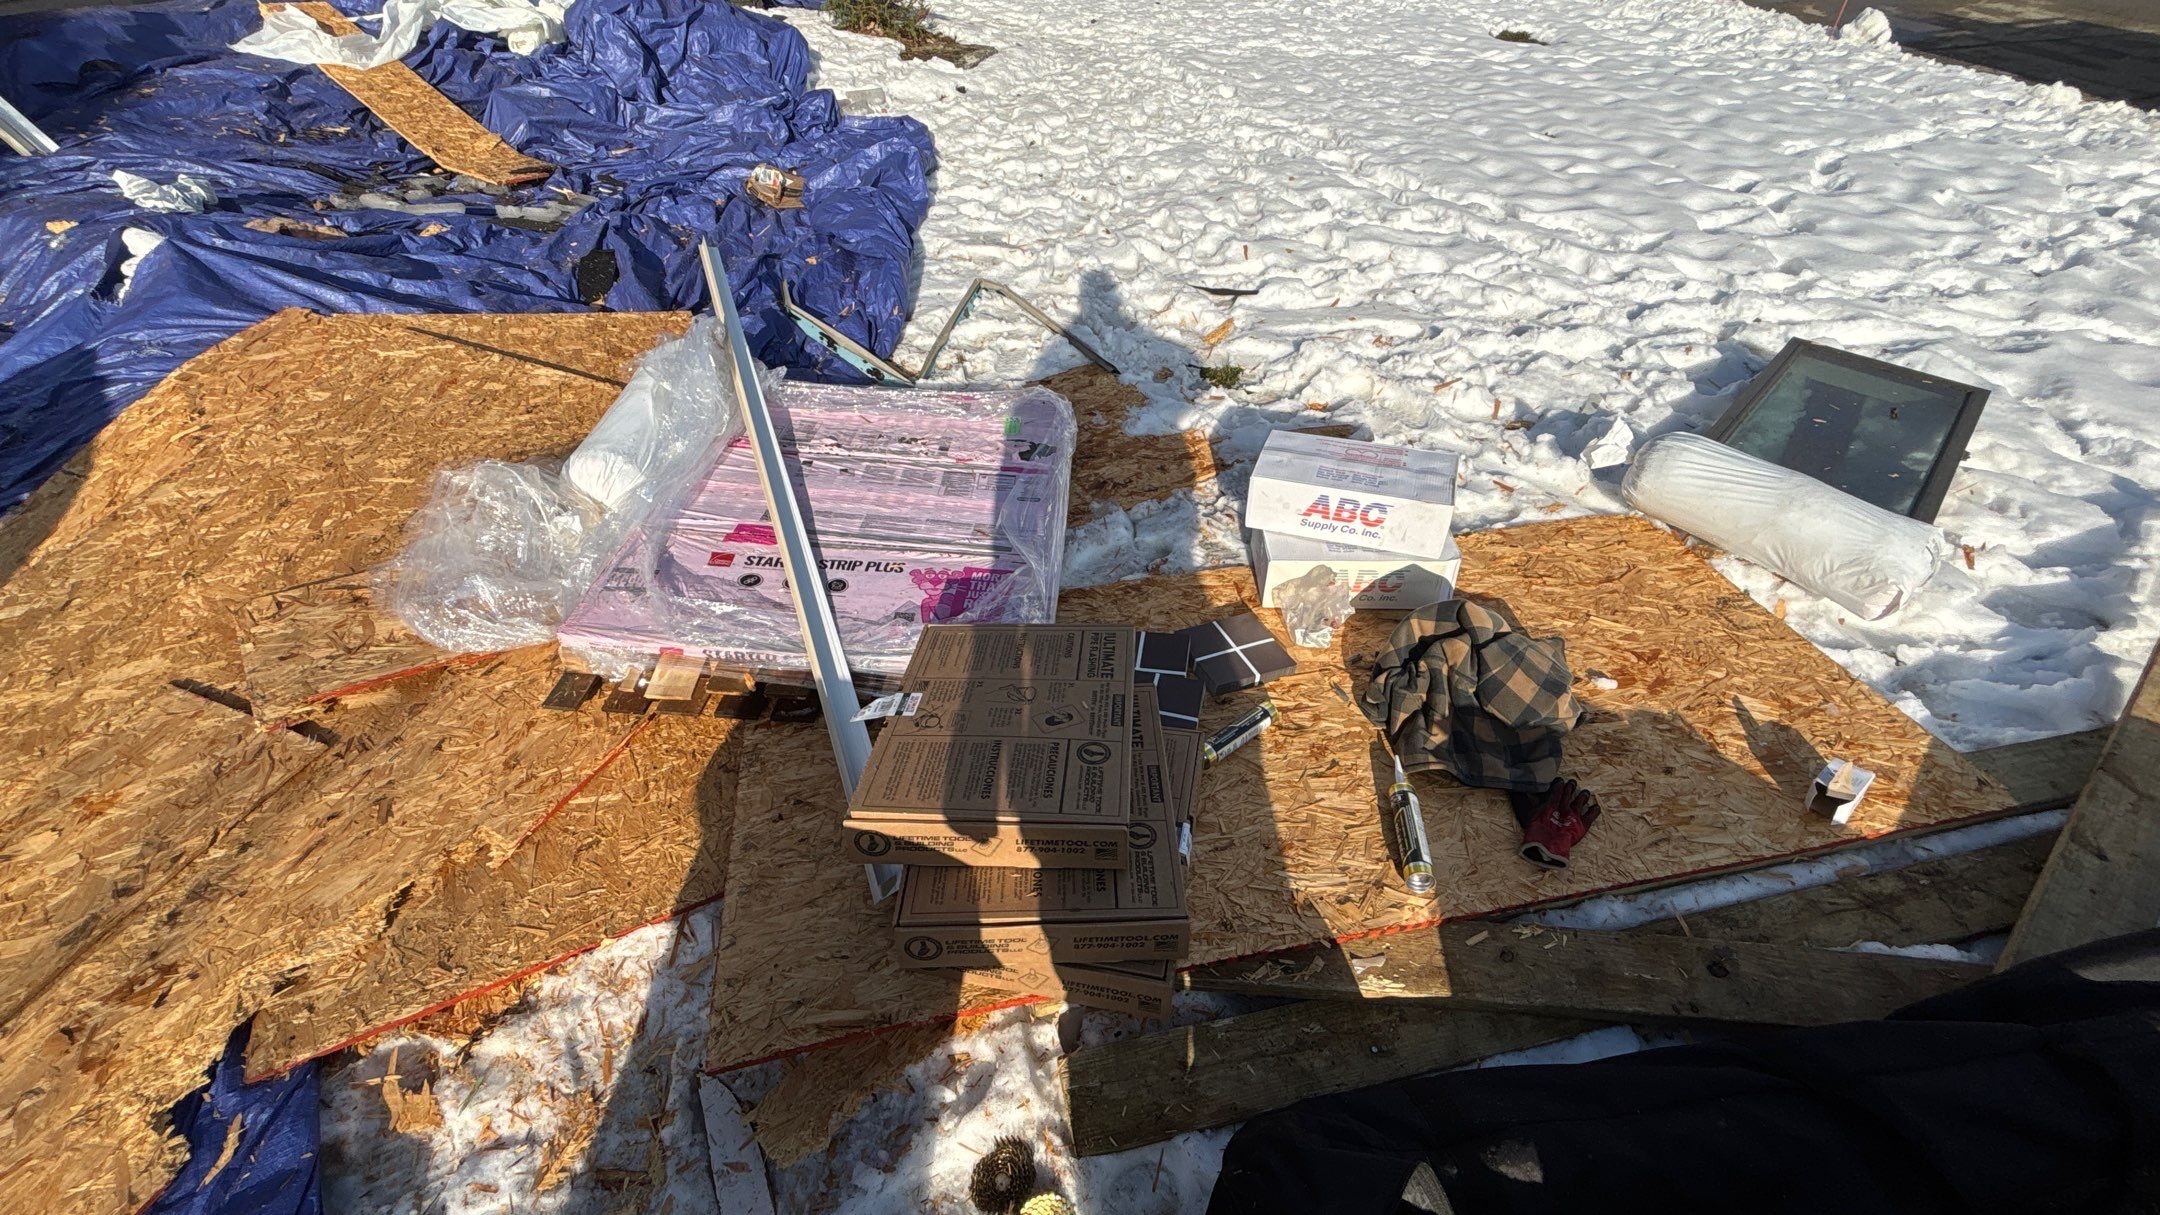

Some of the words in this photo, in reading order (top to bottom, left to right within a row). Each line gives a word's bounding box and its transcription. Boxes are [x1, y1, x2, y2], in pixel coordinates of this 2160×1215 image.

[1298, 494, 1394, 528] ABC
[1300, 518, 1338, 533] Supply
[1340, 525, 1358, 536] Co.
[744, 555, 784, 568] STAR
[819, 559, 863, 571] STRIP
[865, 561, 906, 574] PLUS
[969, 580, 995, 592] THA
[971, 572, 1001, 582] MOR
[1359, 594, 1376, 602] Co.
[1064, 632, 1075, 659] CAUTIONS
[1089, 632, 1099, 646] PIPE
[1087, 646, 1098, 679] FLASHING
[1101, 635, 1116, 679] ULTIMATE
[981, 740, 1002, 800] INSTRUCCIONES
[1043, 742, 1060, 799] PRECAUCIONES
[1015, 839, 1118, 847] LIFETIMETOOL.COM
[1073, 934, 1178, 942] LIFETIMETOOL.COM
[1073, 942, 1145, 950] 877-904-1002
[1062, 980, 1162, 1002] LIFETIMETOOL.COM
[1062, 985, 1129, 1003] 877-904-1002
